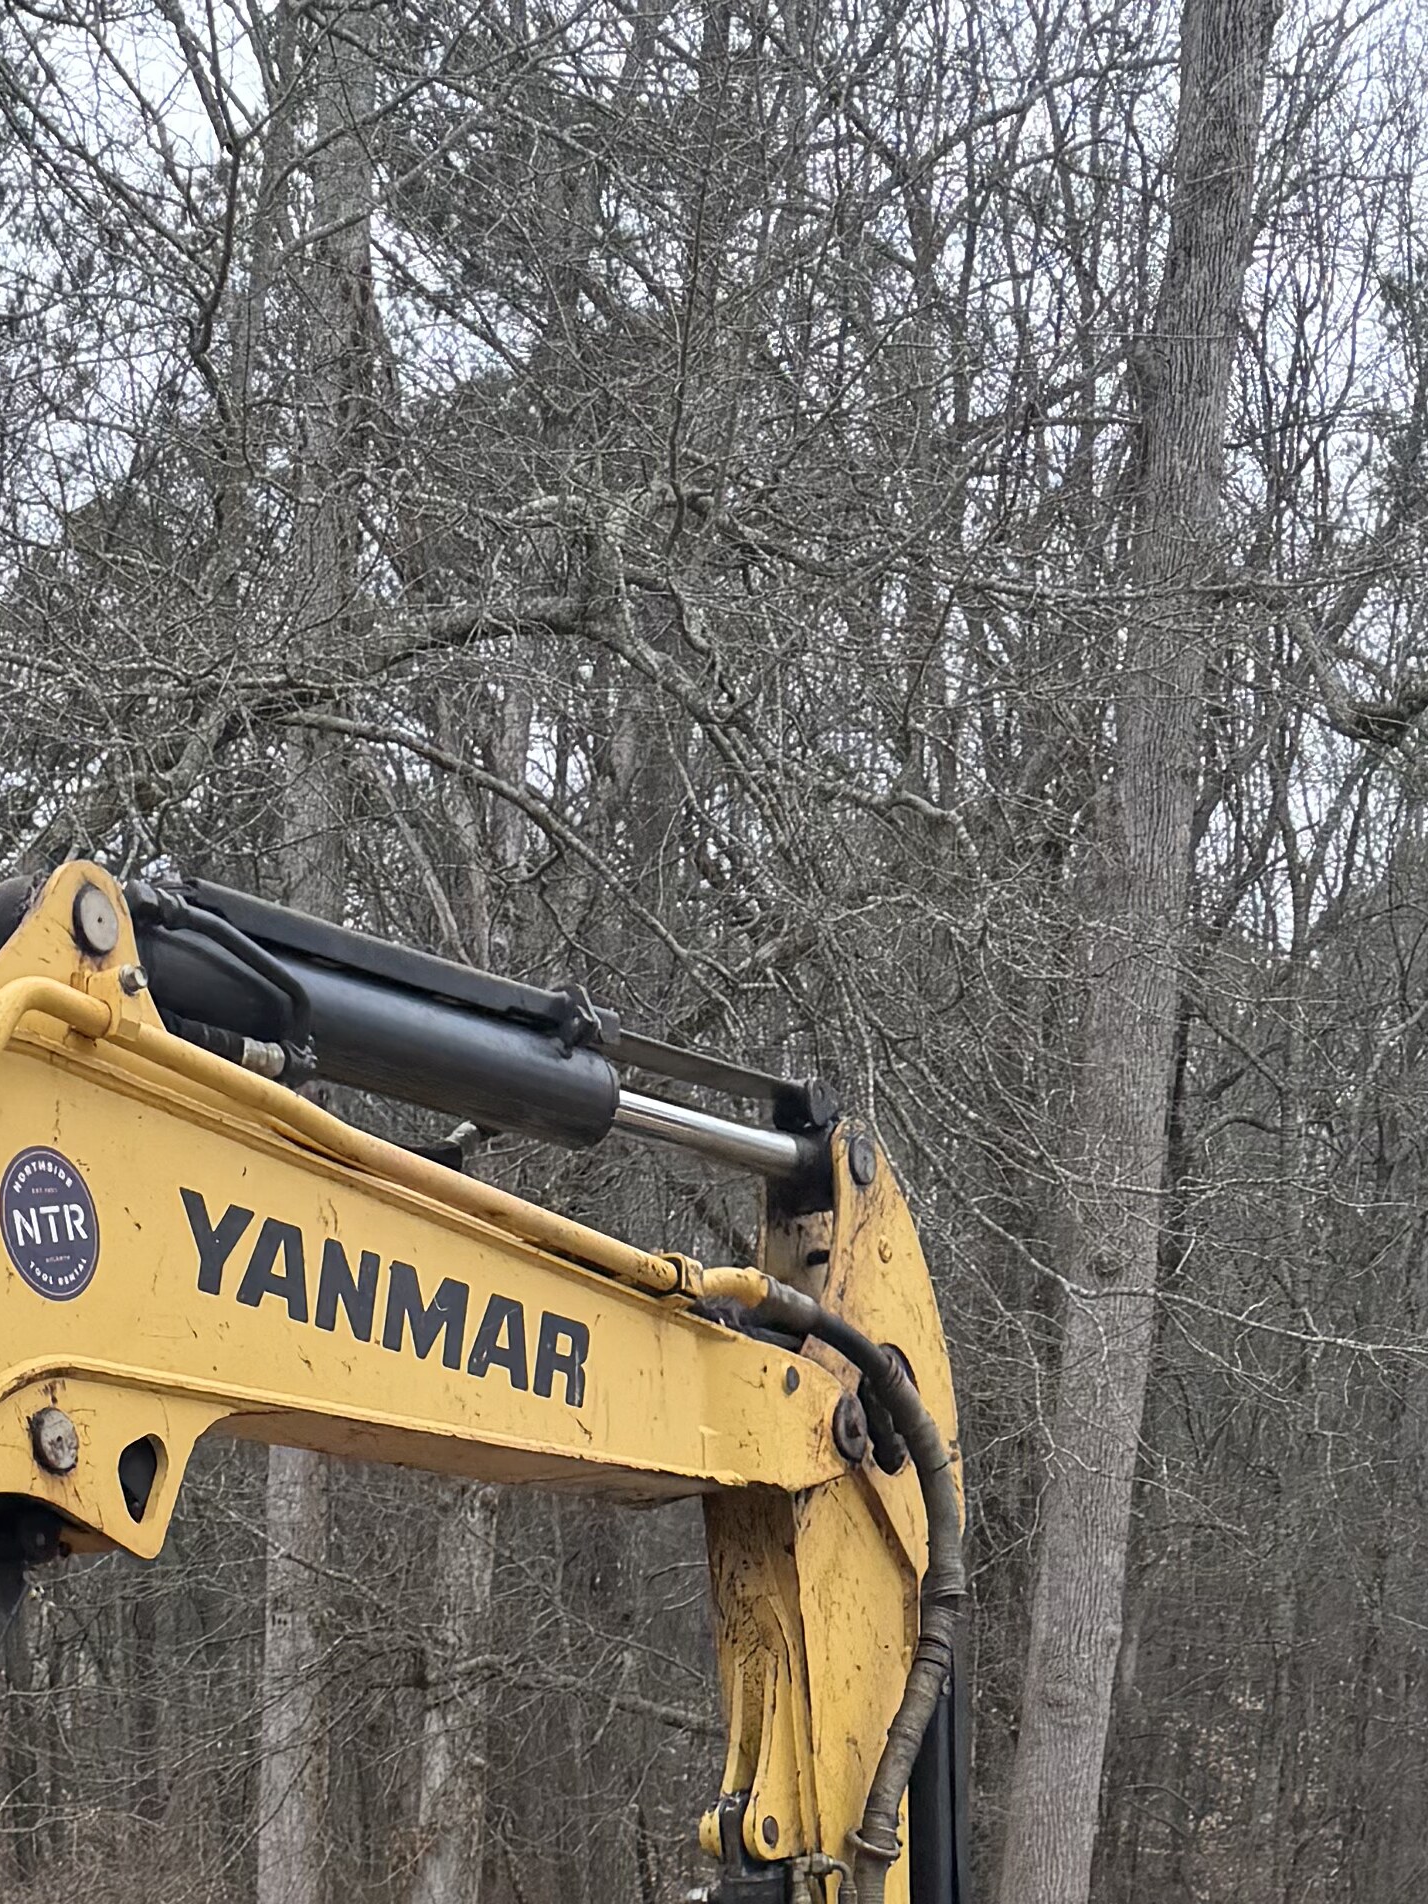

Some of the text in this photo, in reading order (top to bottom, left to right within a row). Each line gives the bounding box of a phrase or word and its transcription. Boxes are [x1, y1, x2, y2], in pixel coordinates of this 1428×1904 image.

[13, 1160, 73, 1193] NORTHSIDE
[12, 1204, 88, 1246] NTR
[29, 1258, 87, 1286] TOOL RENTAL
[179, 1186, 590, 1408] YANMAR
